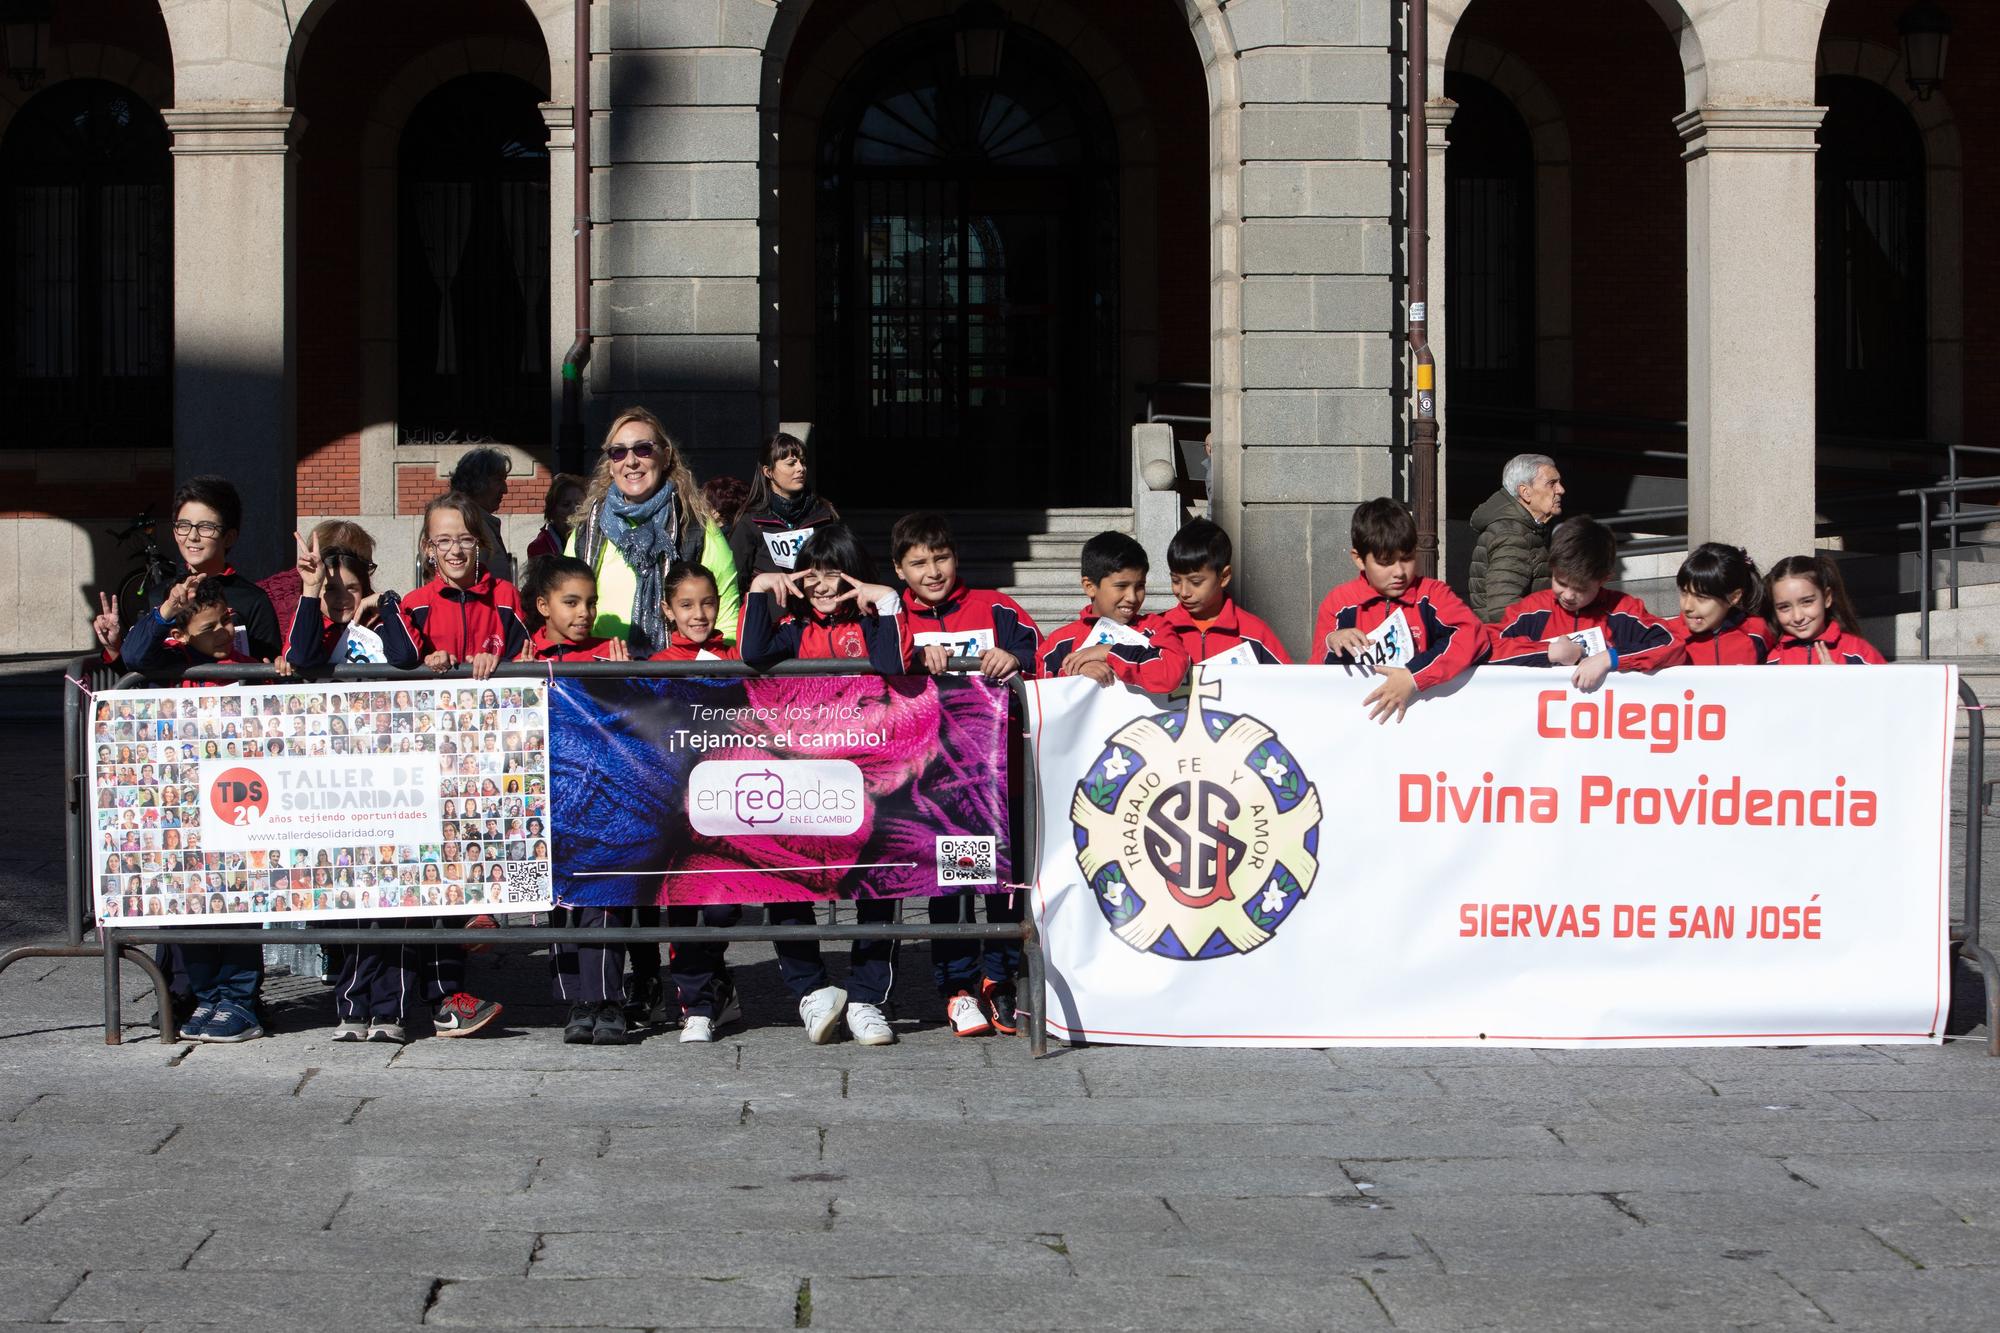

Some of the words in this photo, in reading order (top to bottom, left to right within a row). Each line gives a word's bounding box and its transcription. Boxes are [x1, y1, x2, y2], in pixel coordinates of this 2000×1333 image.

[689, 704, 778, 721] Tenemos
[784, 703, 811, 721] los
[1537, 688, 1727, 754] Colegio
[669, 729, 767, 752] ¡Tejamos
[774, 729, 793, 748] el
[799, 728, 887, 747] cambio!
[278, 769, 374, 789] TALLER
[393, 767, 424, 786] DE
[217, 781, 263, 803] TDS
[281, 789, 425, 811] SOLIDARIDAD
[697, 775, 856, 815] enredadas
[1398, 771, 1559, 824] Divina
[1579, 773, 1878, 827] Providencia
[268, 814, 292, 824] años
[299, 813, 346, 824] tejiendo
[351, 811, 428, 823] oportunidades
[789, 815, 802, 824] EN
[804, 815, 814, 824] EL
[816, 815, 853, 824] CAMBIO
[1123, 772, 1161, 870] TRABAJO
[1177, 757, 1202, 774] FE
[1230, 770, 1244, 785] Y
[1248, 804, 1269, 870] AMOR
[247, 828, 395, 841] www.tallerdesolidaridad.org
[1459, 903, 1601, 939] SIERVAS
[1612, 904, 1657, 939] DE
[1668, 905, 1735, 940] SAN
[1746, 894, 1822, 940] JOSÉ
